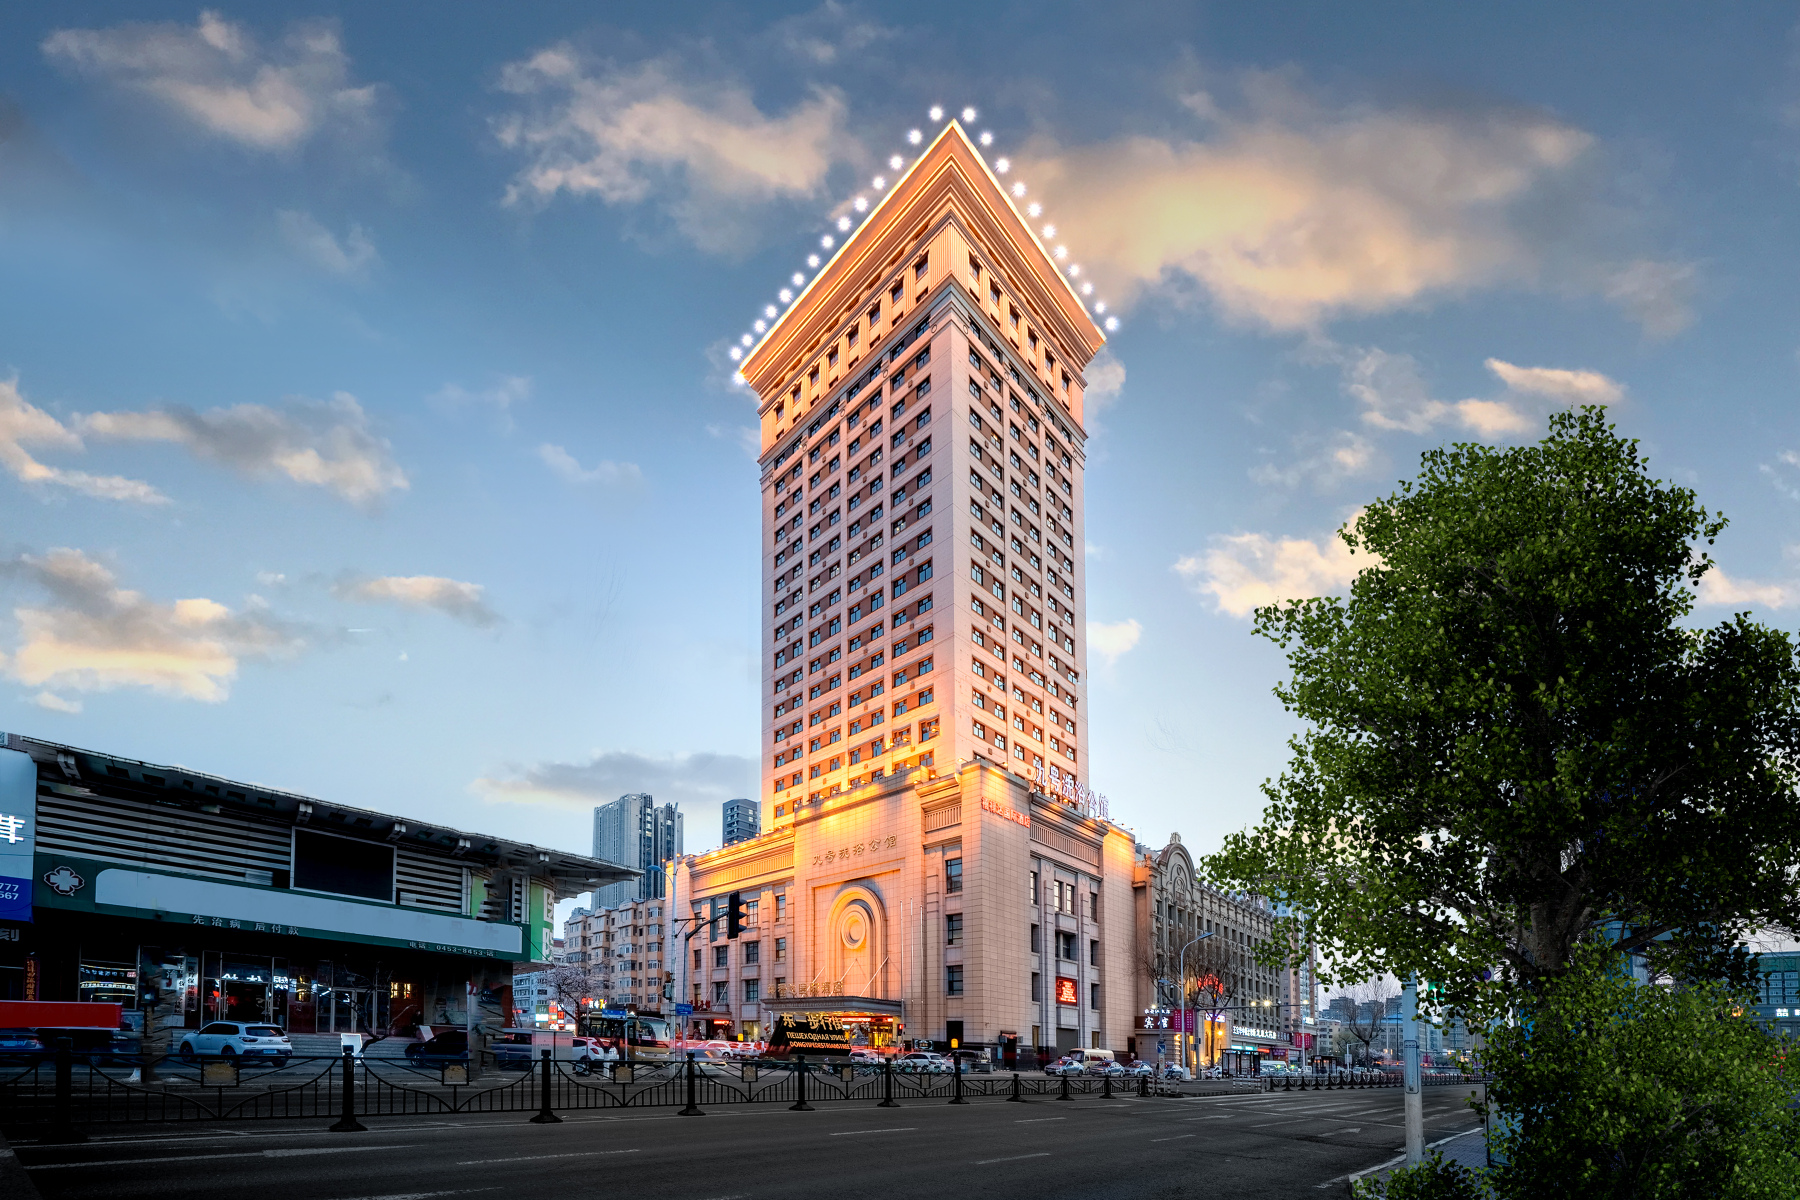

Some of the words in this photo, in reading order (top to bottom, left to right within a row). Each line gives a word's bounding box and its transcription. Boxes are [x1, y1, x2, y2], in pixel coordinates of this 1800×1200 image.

[812, 834, 897, 866] 九号洗浴公馆
